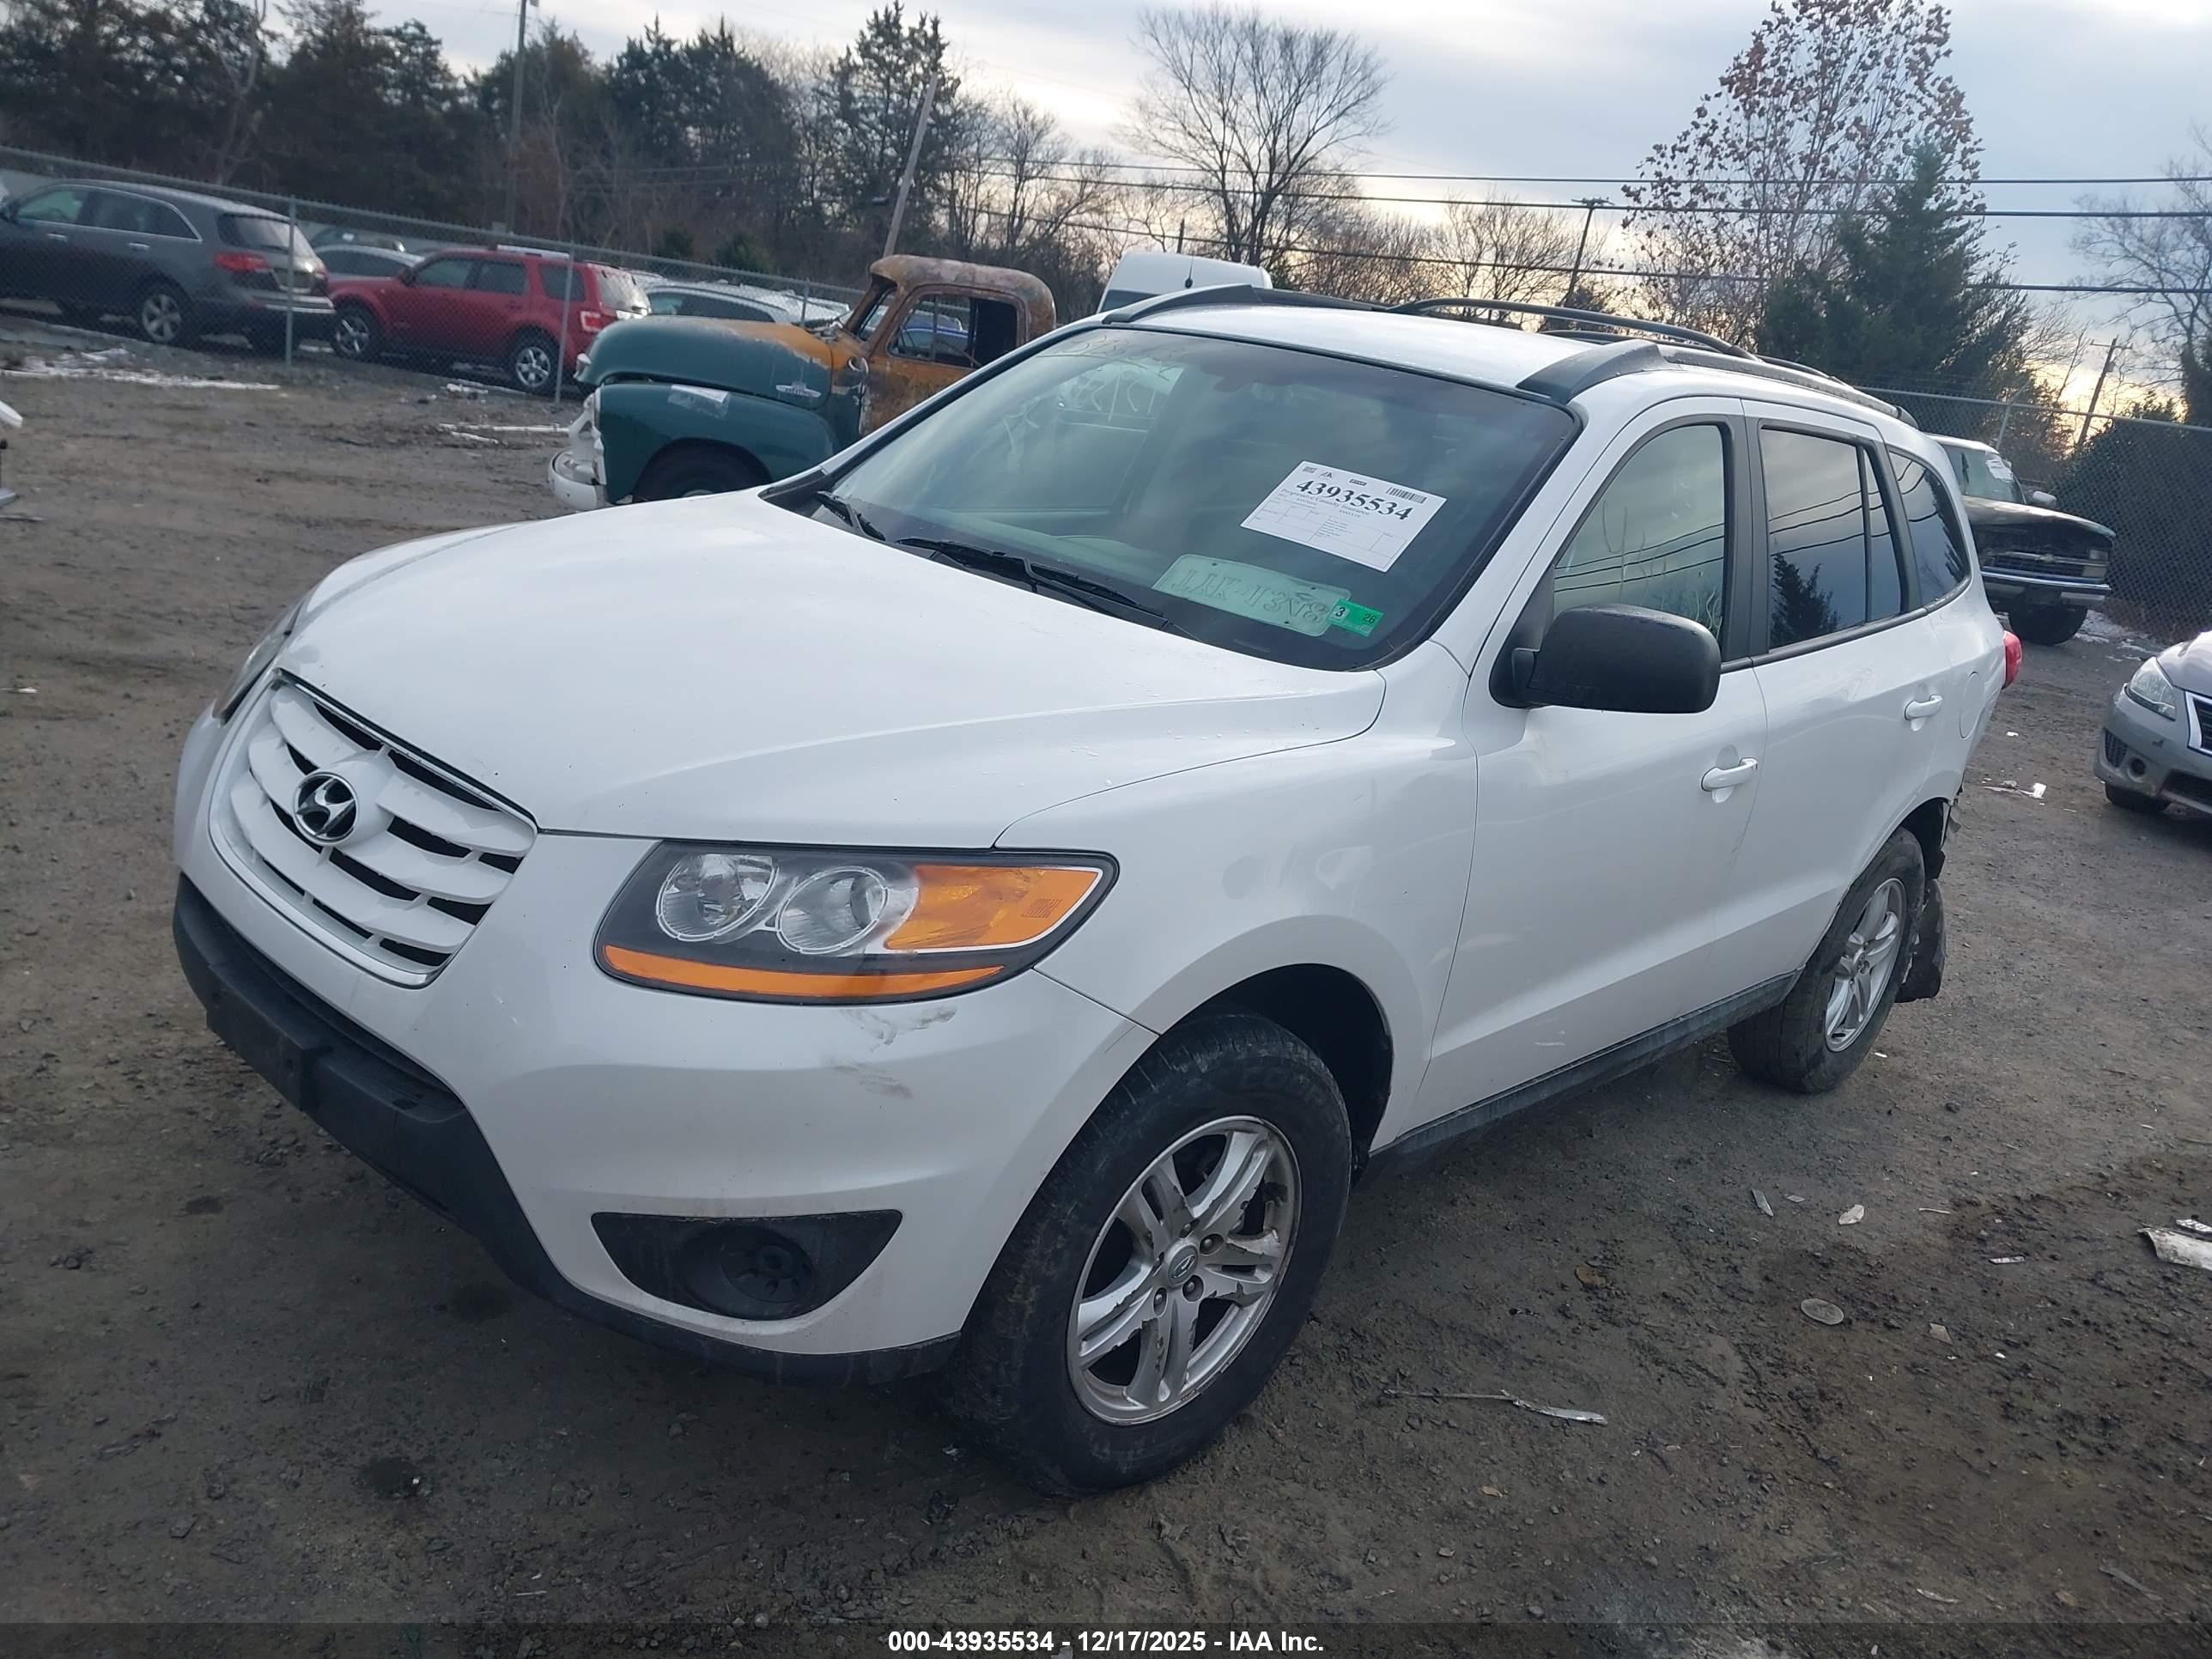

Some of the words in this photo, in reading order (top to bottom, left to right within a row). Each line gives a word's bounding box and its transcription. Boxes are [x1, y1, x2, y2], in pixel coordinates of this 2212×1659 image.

[1296, 479, 1414, 521] 43935534
[1335, 606, 1346, 617] 3
[1362, 612, 1378, 624] 26
